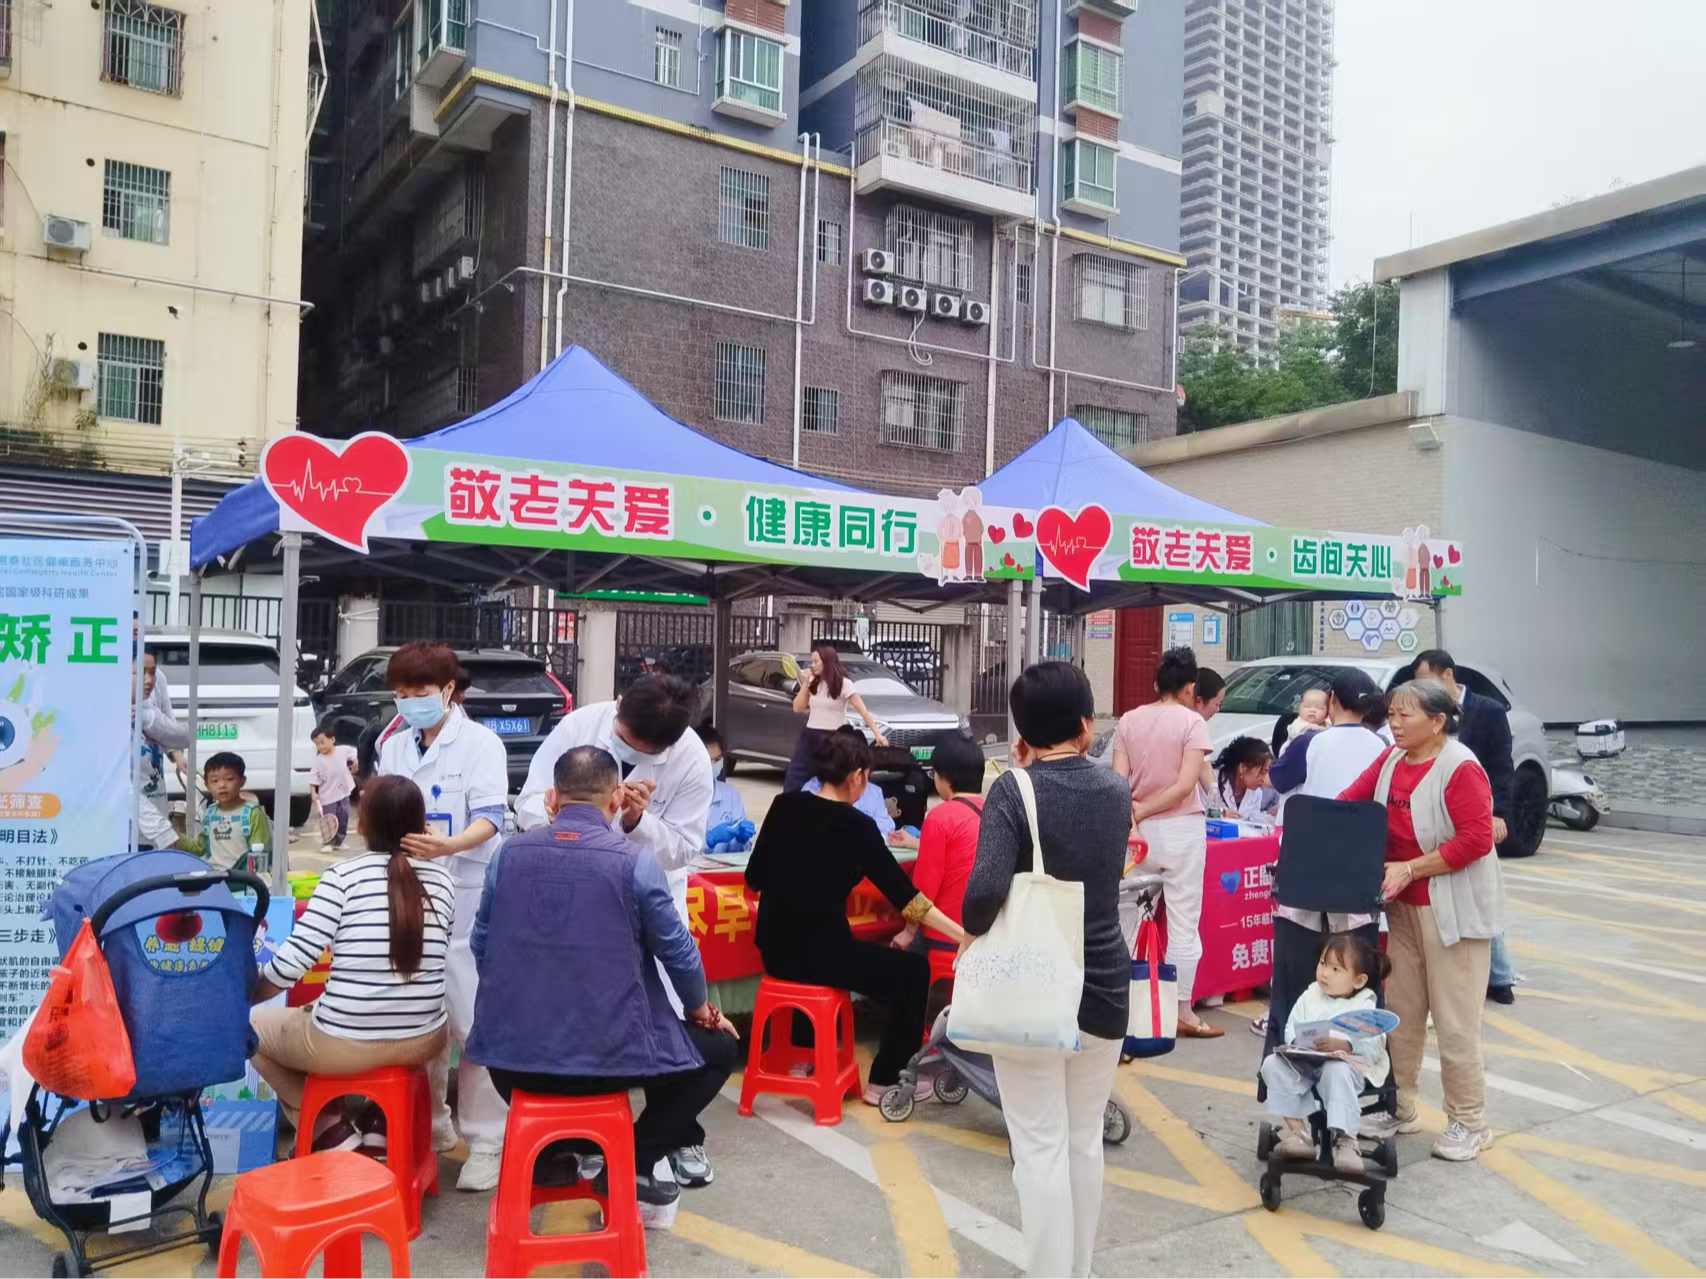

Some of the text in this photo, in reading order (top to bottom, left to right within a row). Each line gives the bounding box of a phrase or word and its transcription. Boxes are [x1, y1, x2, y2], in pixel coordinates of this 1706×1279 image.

[449, 466, 918, 554] 敬老关爱 健康同行
[1132, 526, 1392, 579] 敬老关爱 齿间关心
[1231, 938, 1275, 971] 免费
